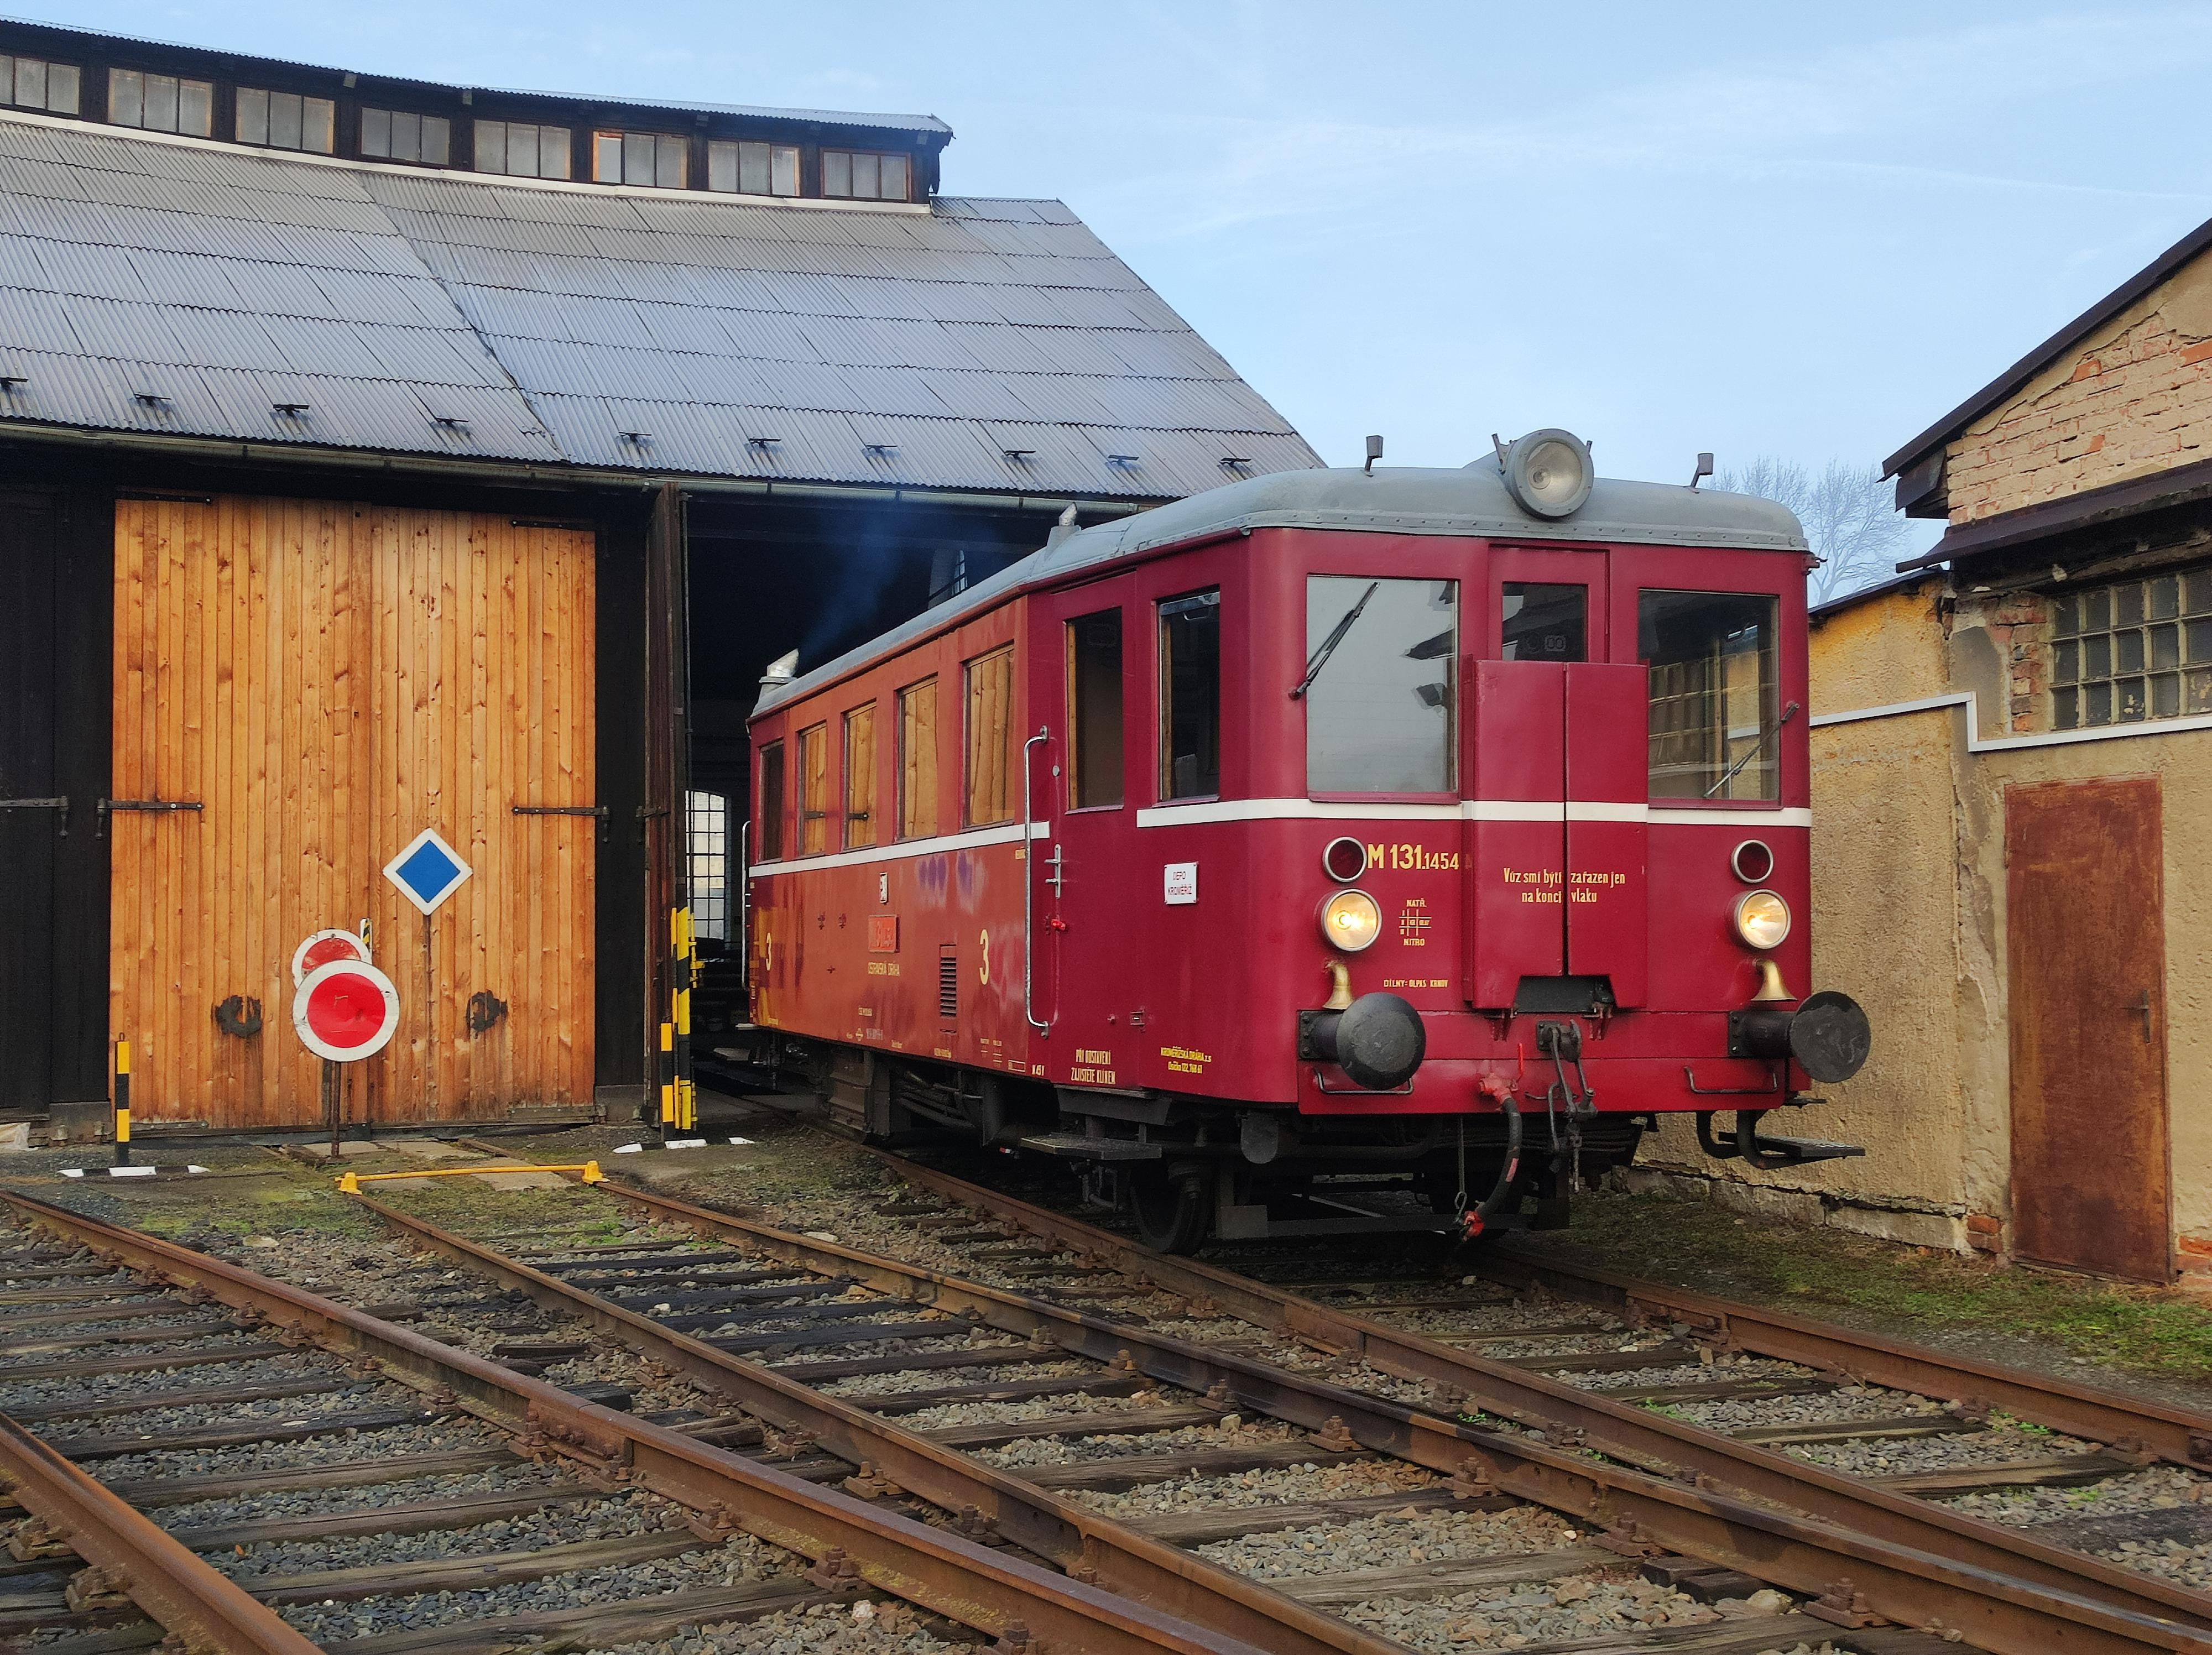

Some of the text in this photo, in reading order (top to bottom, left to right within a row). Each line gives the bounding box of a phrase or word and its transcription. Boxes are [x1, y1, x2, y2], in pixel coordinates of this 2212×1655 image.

[1367, 844, 1459, 870] M 131.1454
[1173, 871, 1186, 880] DEPO
[1571, 871, 1609, 884] zařazen
[1610, 871, 1626, 888] jen
[1167, 884, 1192, 895] KROMĚŘÍŽ
[1522, 891, 1534, 903] na
[1571, 887, 1597, 903] vlaku
[1403, 938, 1425, 946] NITRO
[765, 932, 772, 971] 3
[979, 929, 989, 985] 3
[1076, 1048, 1084, 1063] PŘI
